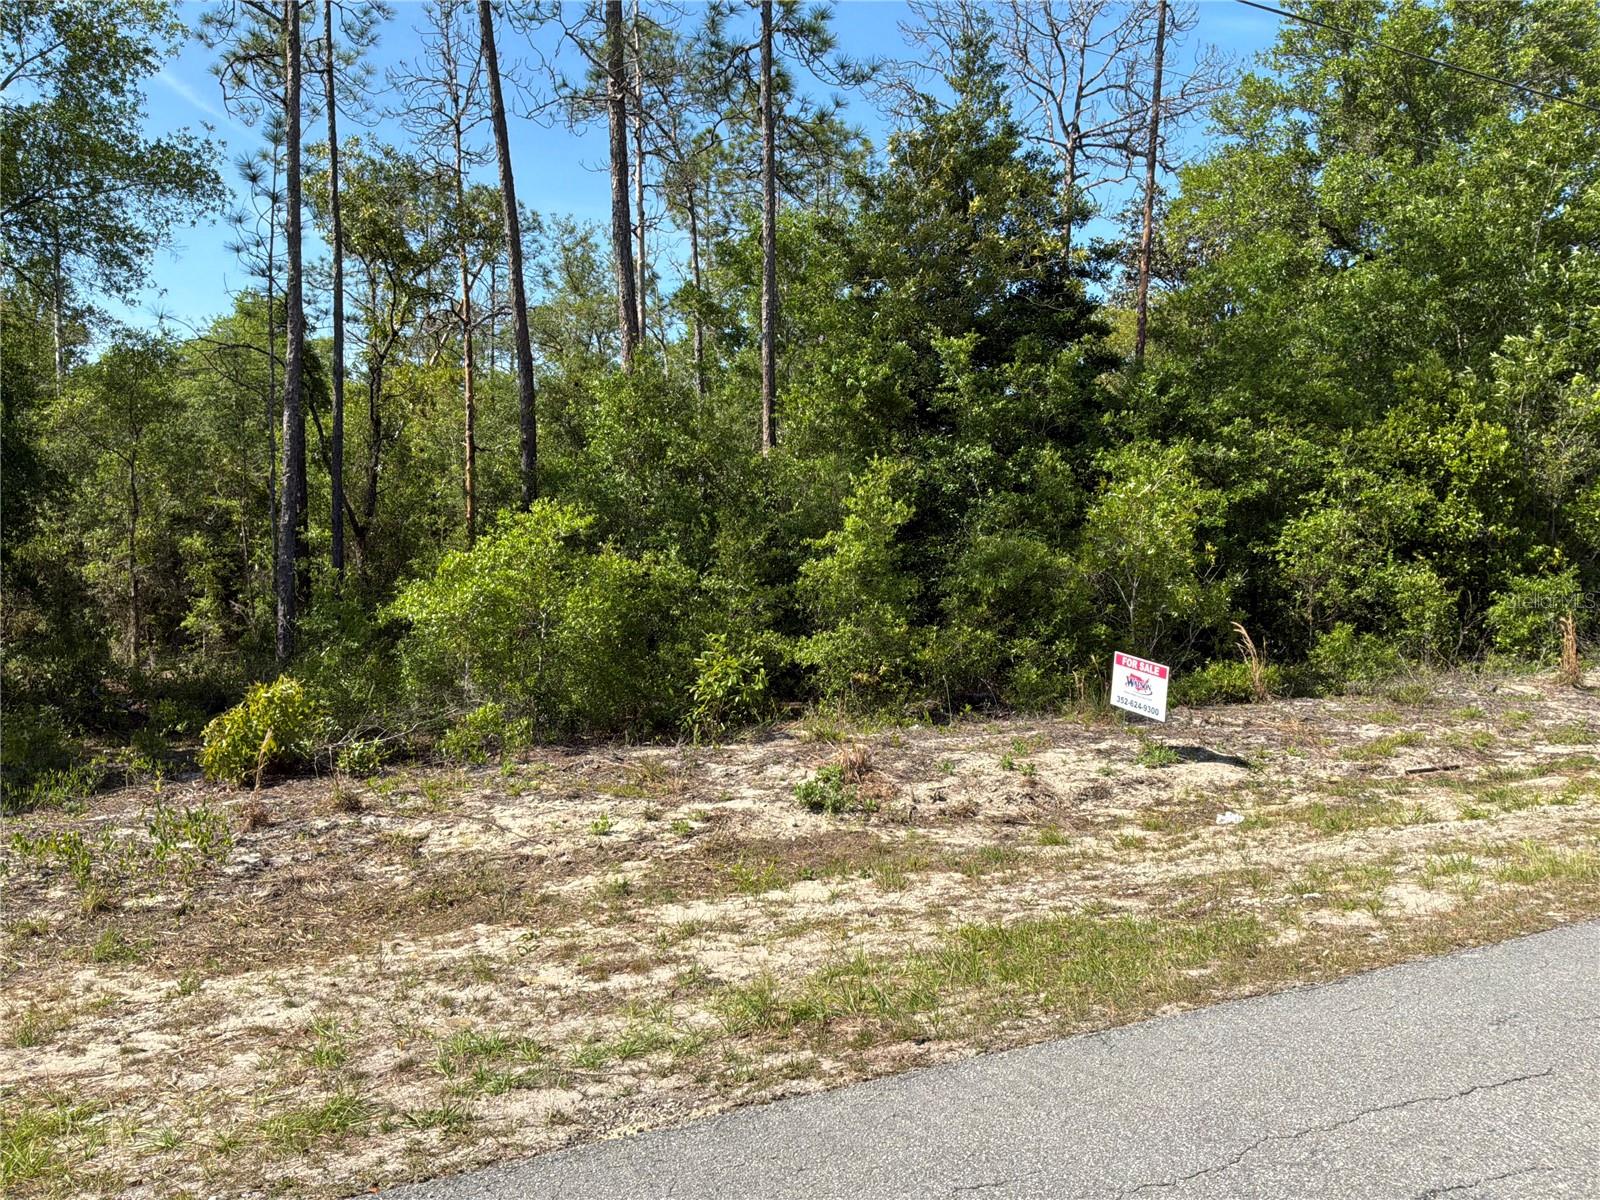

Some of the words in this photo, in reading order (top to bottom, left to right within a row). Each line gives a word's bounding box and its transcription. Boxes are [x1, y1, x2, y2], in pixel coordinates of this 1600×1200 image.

[1122, 657, 1137, 669] FOR
[1139, 661, 1160, 675] SALE
[1116, 695, 1160, 716] 352-624-9300
